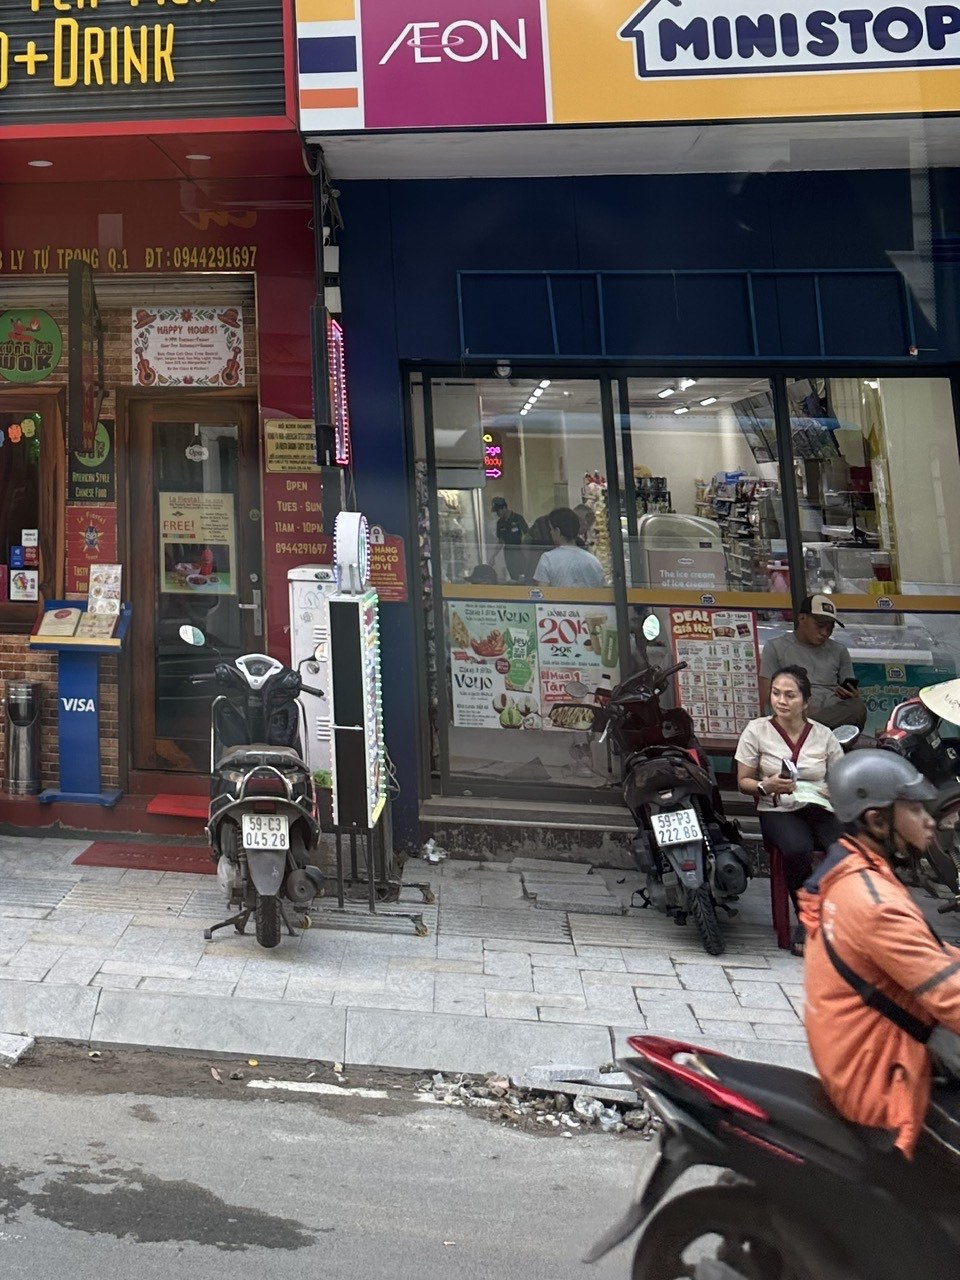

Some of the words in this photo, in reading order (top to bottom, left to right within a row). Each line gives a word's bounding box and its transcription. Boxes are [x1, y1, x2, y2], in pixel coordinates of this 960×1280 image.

[660, 5, 960, 62] MINISTOP
[156, 324, 183, 335] HAPPY
[96, 471, 110, 483] STYLE
[286, 480, 308, 491] OPEN
[277, 501, 297, 512] TUES
[305, 501, 322, 512] SUN
[163, 520, 195, 531] FREE!
[275, 522, 295, 533] 11AM
[275, 543, 328, 554] 0944291697
[659, 569, 675, 578] The
[676, 570, 688, 578] ice
[690, 571, 716, 579] cream
[497, 609, 530, 623] Veyo
[672, 610, 709, 623] DEAL
[550, 671, 570, 680] Mua
[454, 674, 493, 690] Veyo
[542, 680, 567, 694] Tặn
[60, 697, 96, 712] VISA
[658, 811, 691, 828] 59-P3
[246, 832, 286, 847] 045.28
